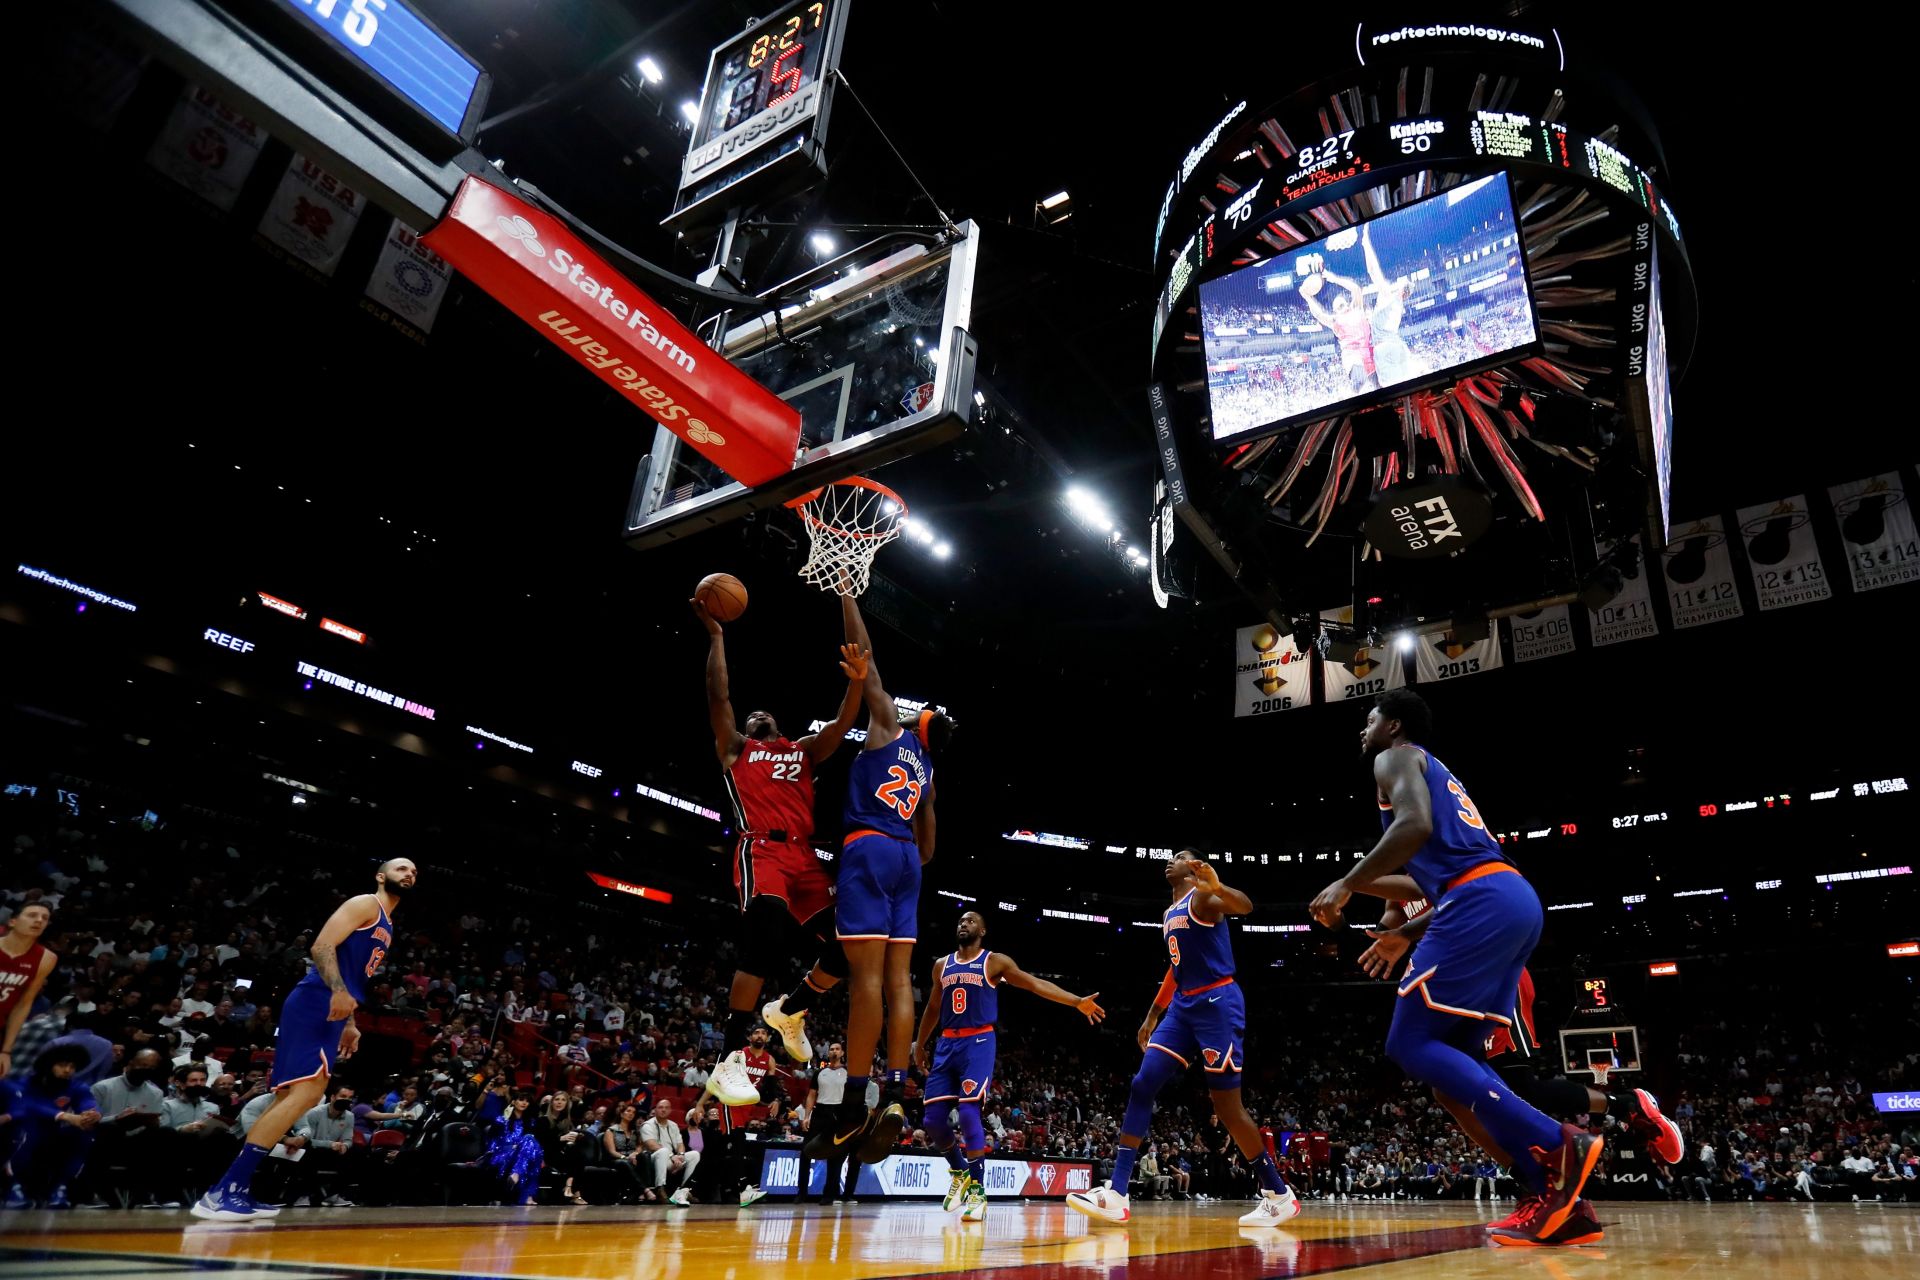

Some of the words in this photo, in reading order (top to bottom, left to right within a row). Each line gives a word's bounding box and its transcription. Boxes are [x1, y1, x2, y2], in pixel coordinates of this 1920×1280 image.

[749, 2, 823, 68] 8:27
[1372, 25, 1544, 49] reeftechnology.com
[768, 44, 804, 108] 5
[723, 93, 812, 153] TISSOT
[1389, 119, 1445, 140] Knicks
[1483, 120, 1523, 131] BARRETT
[1484, 127, 1520, 138] RANDLE
[1298, 130, 1356, 168] 8:27
[1401, 136, 1432, 155] 50
[1485, 134, 1532, 146] ROBINSON
[1486, 141, 1532, 153] FOURNIER
[1487, 148, 1525, 158] WALKER
[1282, 186, 1290, 195] 5
[1308, 169, 1330, 182] TOL
[1353, 156, 1361, 165] 4
[1286, 157, 1338, 185] QUARTER
[1346, 151, 1353, 160] 3
[1286, 182, 1318, 202] TEAM
[1318, 167, 1356, 188] FOULS
[1362, 163, 1371, 172] 2
[1231, 204, 1252, 230] 70
[1391, 506, 1428, 550] arena
[1414, 495, 1462, 544] FTX
[1852, 551, 1875, 571] 13
[1895, 541, 1920, 561] 14
[1757, 571, 1780, 590] 12
[1798, 561, 1822, 581] 13
[18, 564, 137, 612] reeftechnology.com
[1672, 590, 1694, 609] 11
[1710, 582, 1734, 601] 12
[1761, 587, 1829, 608] CHAMPIONS
[1595, 607, 1615, 626] 10
[1629, 600, 1649, 619] 11
[1676, 605, 1740, 627] CHAMPIONS
[204, 628, 255, 653] REEF
[1513, 626, 1535, 643] 05
[1547, 618, 1569, 637] 06
[1595, 624, 1655, 644] CHAMPIONS
[1517, 641, 1573, 660] CHAMPIONS
[1438, 658, 1481, 680] 2013
[297, 661, 318, 678] THE
[316, 668, 356, 692] FUTURE
[354, 681, 368, 695] IS
[365, 686, 394, 705] MADE
[393, 695, 406, 709] IN
[1344, 678, 1385, 699] 2012
[1251, 696, 1292, 715] 2006
[465, 724, 534, 753] reeftechnology.com
[748, 750, 804, 762] MIAMI
[898, 746, 927, 787] ROBINSON
[571, 760, 602, 778] REEF
[772, 763, 802, 782] 22
[875, 765, 922, 820] 23
[1871, 777, 1906, 789] BUTLER
[1874, 784, 1909, 795] TUCKER
[637, 783, 649, 796] THE
[648, 786, 672, 804] FUTURE
[671, 795, 679, 806] IS
[677, 798, 696, 814] MADE
[1699, 803, 1718, 817] 50
[1725, 801, 1758, 812] Knicks
[1612, 814, 1639, 829] 8:27
[1660, 812, 1668, 821] 3
[1560, 823, 1577, 835] 70
[1149, 848, 1173, 856] BUTLER
[1755, 879, 1782, 890] REEF
[1815, 874, 1829, 884] THE
[1827, 871, 1854, 883] FUTURE
[1852, 870, 1861, 880] IS
[1859, 868, 1881, 879] MADE
[1879, 868, 1889, 876] IN
[1622, 894, 1647, 904] REEF
[1673, 888, 1724, 898] reeftechnology.com
[998, 901, 1018, 911] REEF
[1051, 909, 1070, 920] FUTURE
[1074, 912, 1089, 921] MADE
[1547, 902, 1594, 911] reeftechnology.com
[1251, 924, 1269, 932] FUTURE
[1274, 924, 1289, 932] MADE
[1168, 935, 1181, 966] 9
[959, 972, 984, 987] YORK
[1584, 980, 1606, 991] 8:27
[952, 987, 967, 1015] 8
[1593, 989, 1606, 1006] 5
[893, 1162, 931, 1188] #NBA75
[986, 1166, 1016, 1189] #NBA75
[1065, 1168, 1091, 1190] #NBA75
